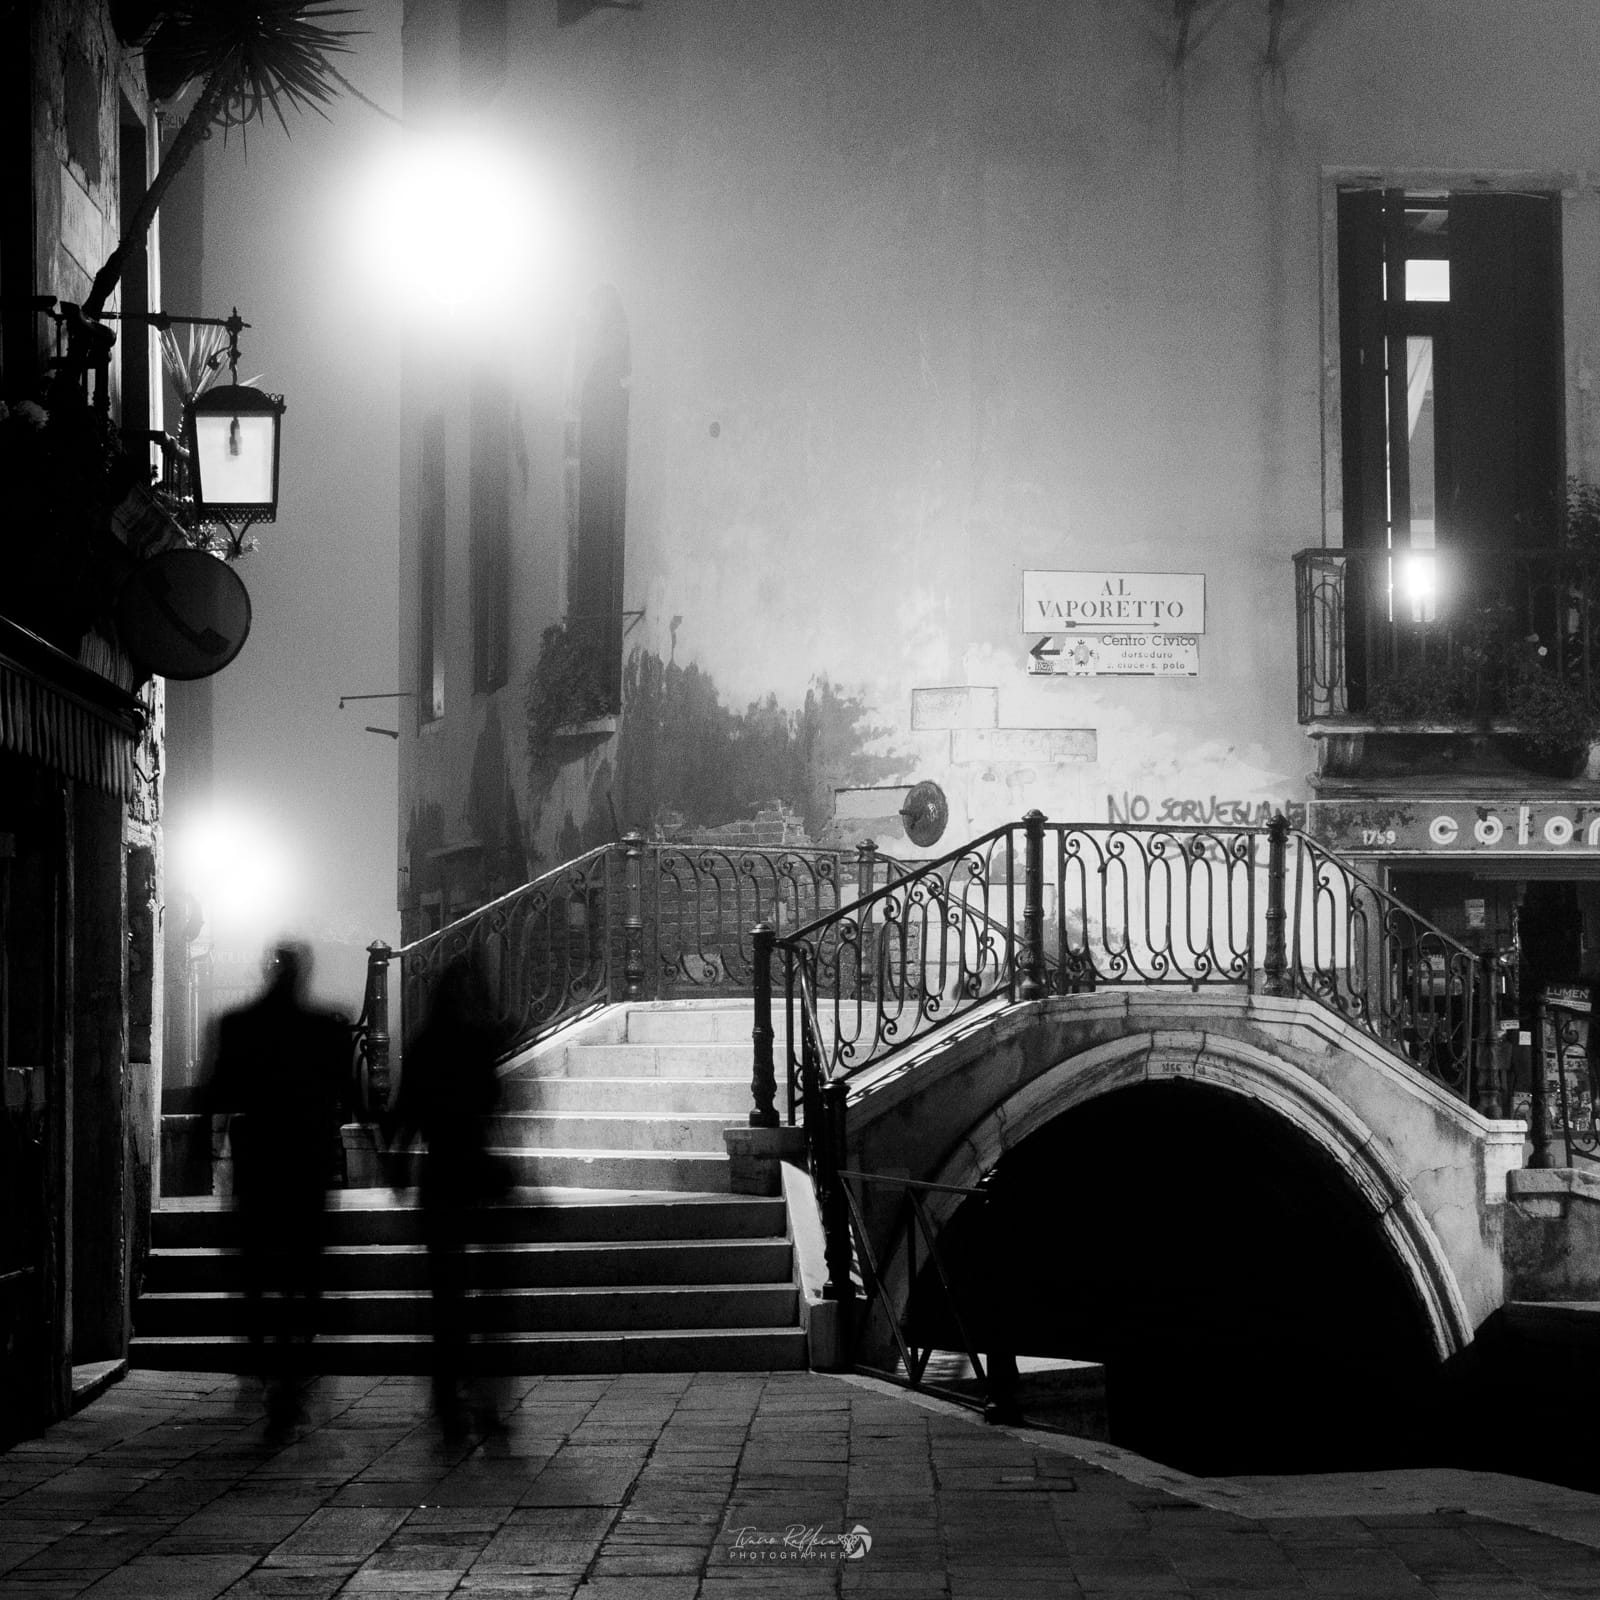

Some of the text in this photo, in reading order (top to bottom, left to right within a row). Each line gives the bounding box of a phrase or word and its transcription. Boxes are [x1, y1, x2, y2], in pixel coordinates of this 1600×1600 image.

[1101, 578, 1131, 596] AL
[1037, 600, 1184, 618] VAPORETTO
[1102, 635, 1196, 646] Centro Civico
[1163, 661, 1185, 670] polo
[1107, 791, 1150, 824] NO
[1546, 986, 1589, 999] LUMEN
